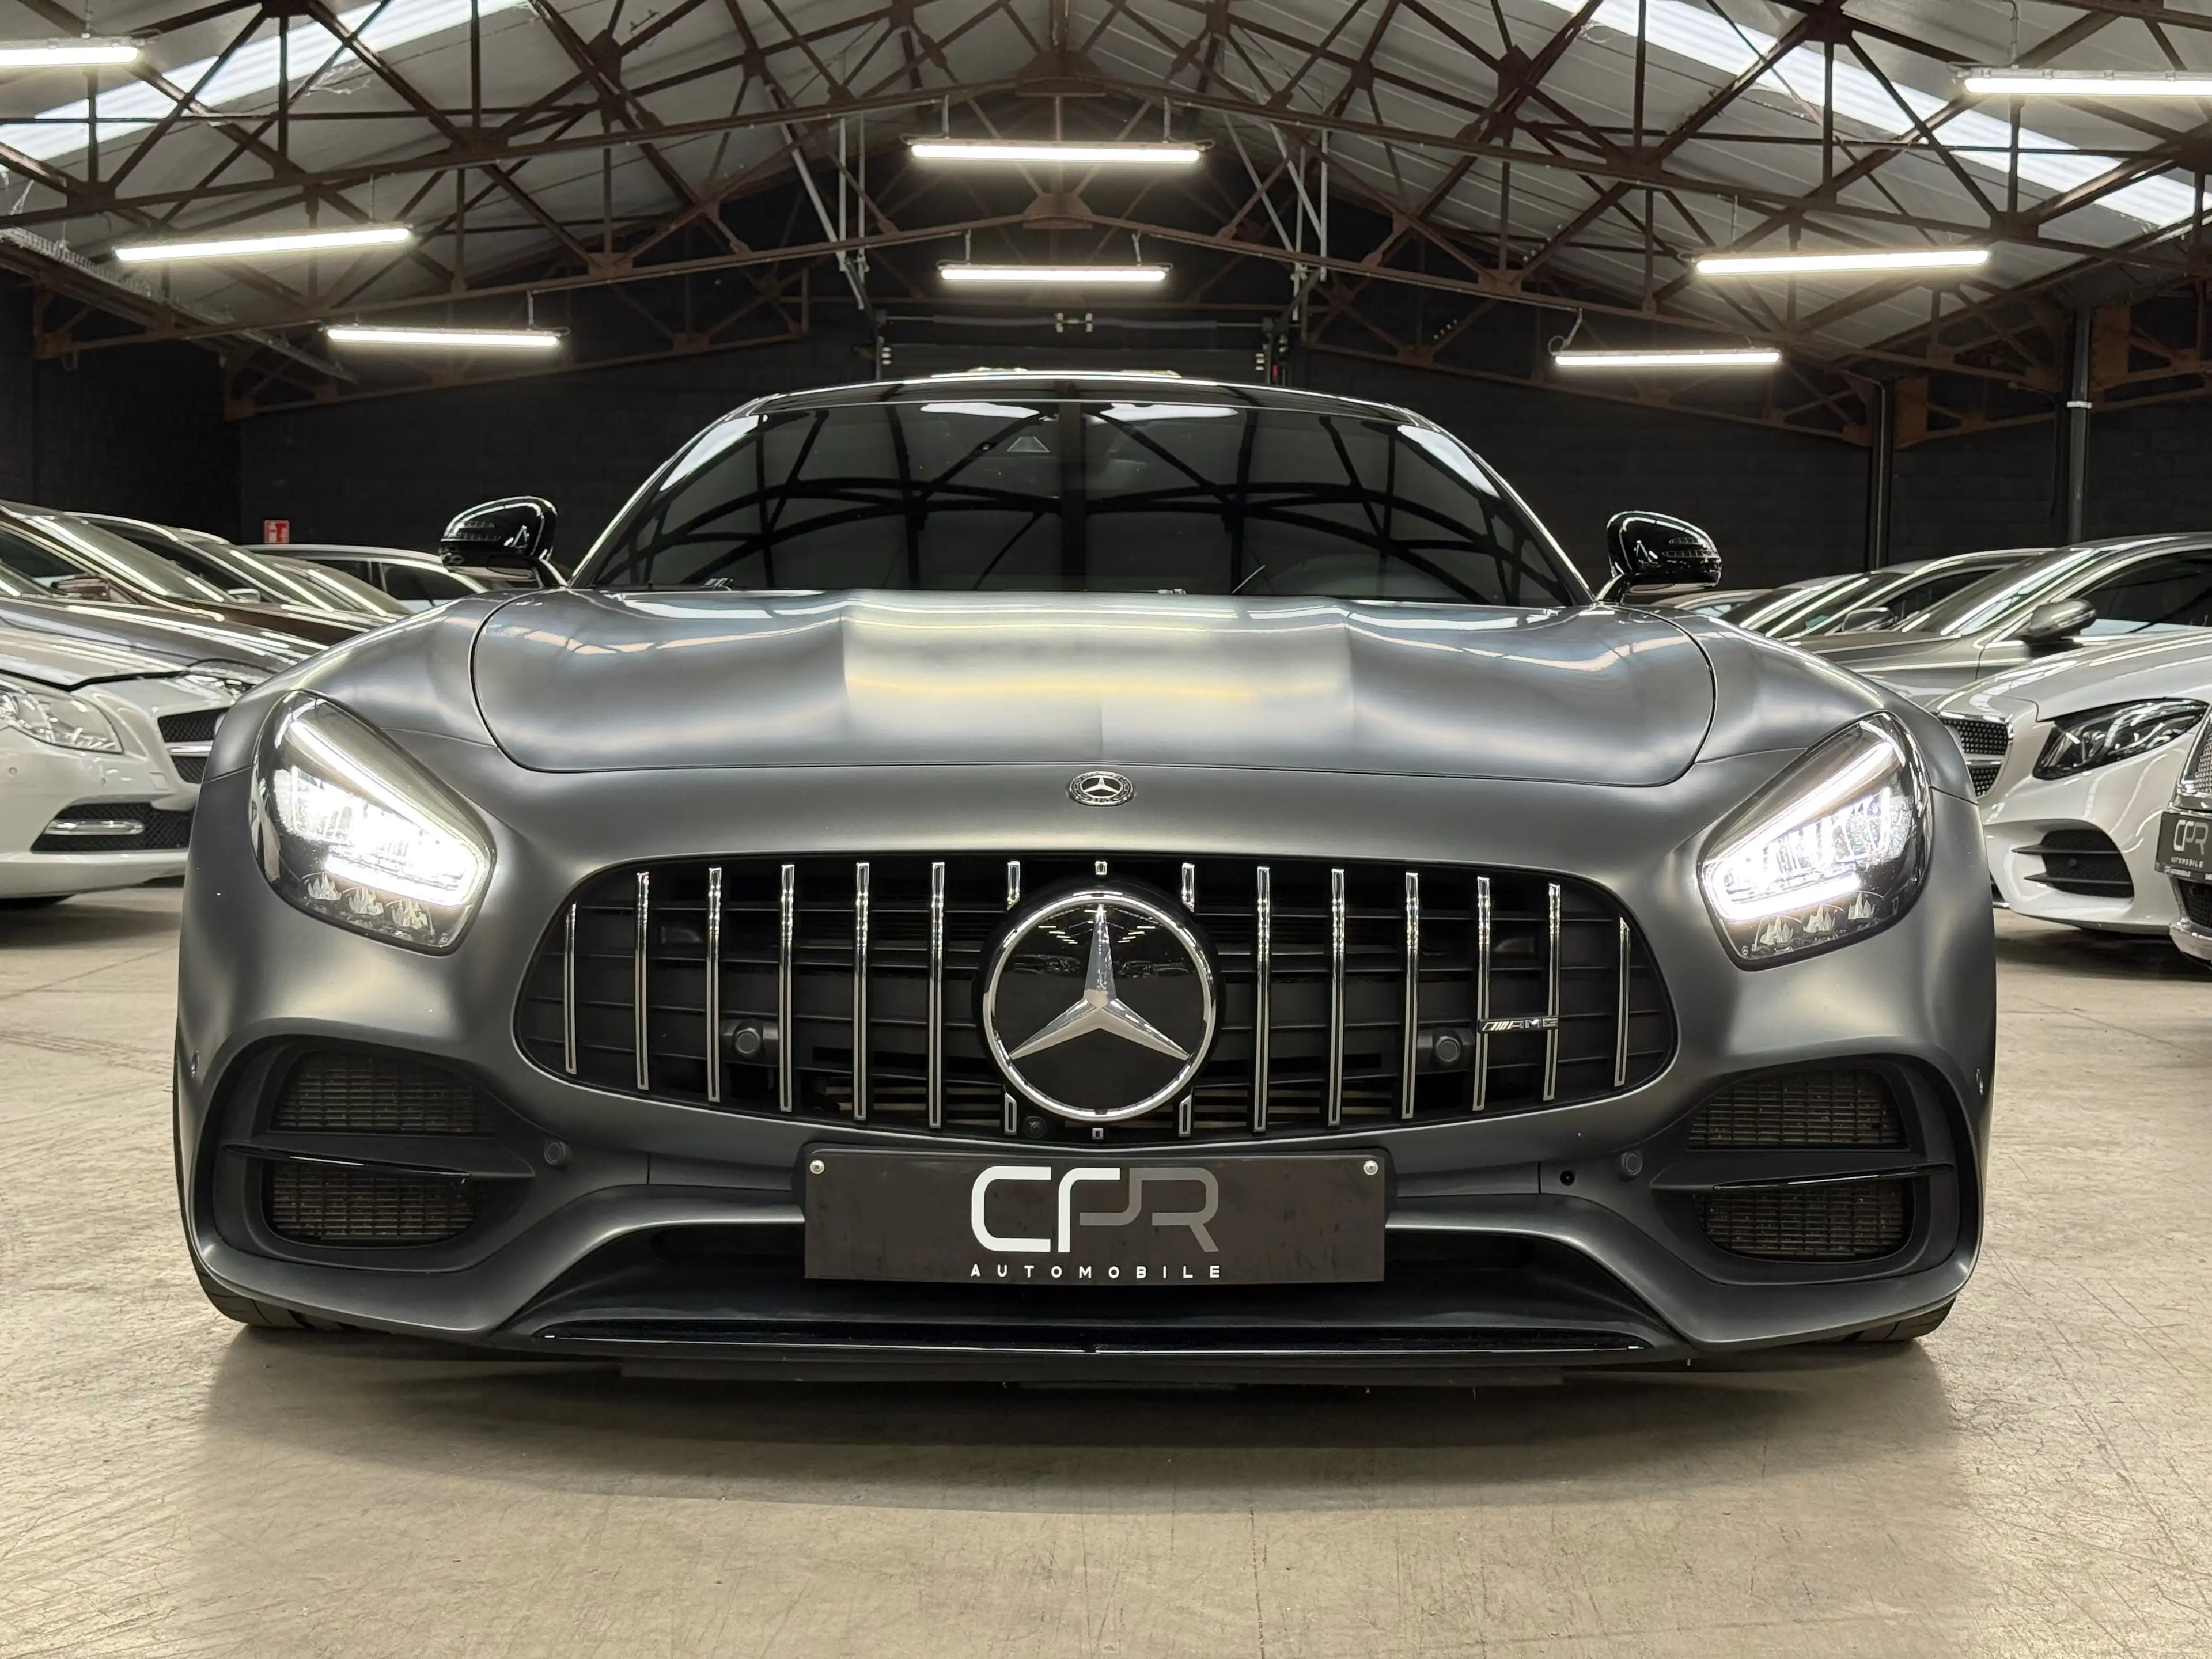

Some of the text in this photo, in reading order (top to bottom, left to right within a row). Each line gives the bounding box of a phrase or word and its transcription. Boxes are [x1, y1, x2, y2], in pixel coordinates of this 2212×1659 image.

[2174, 819, 2209, 855] CPR
[1506, 1018, 1559, 1030] AMG
[971, 1166, 1219, 1253] CPR
[971, 1264, 1221, 1279] AUTOMOBILE
